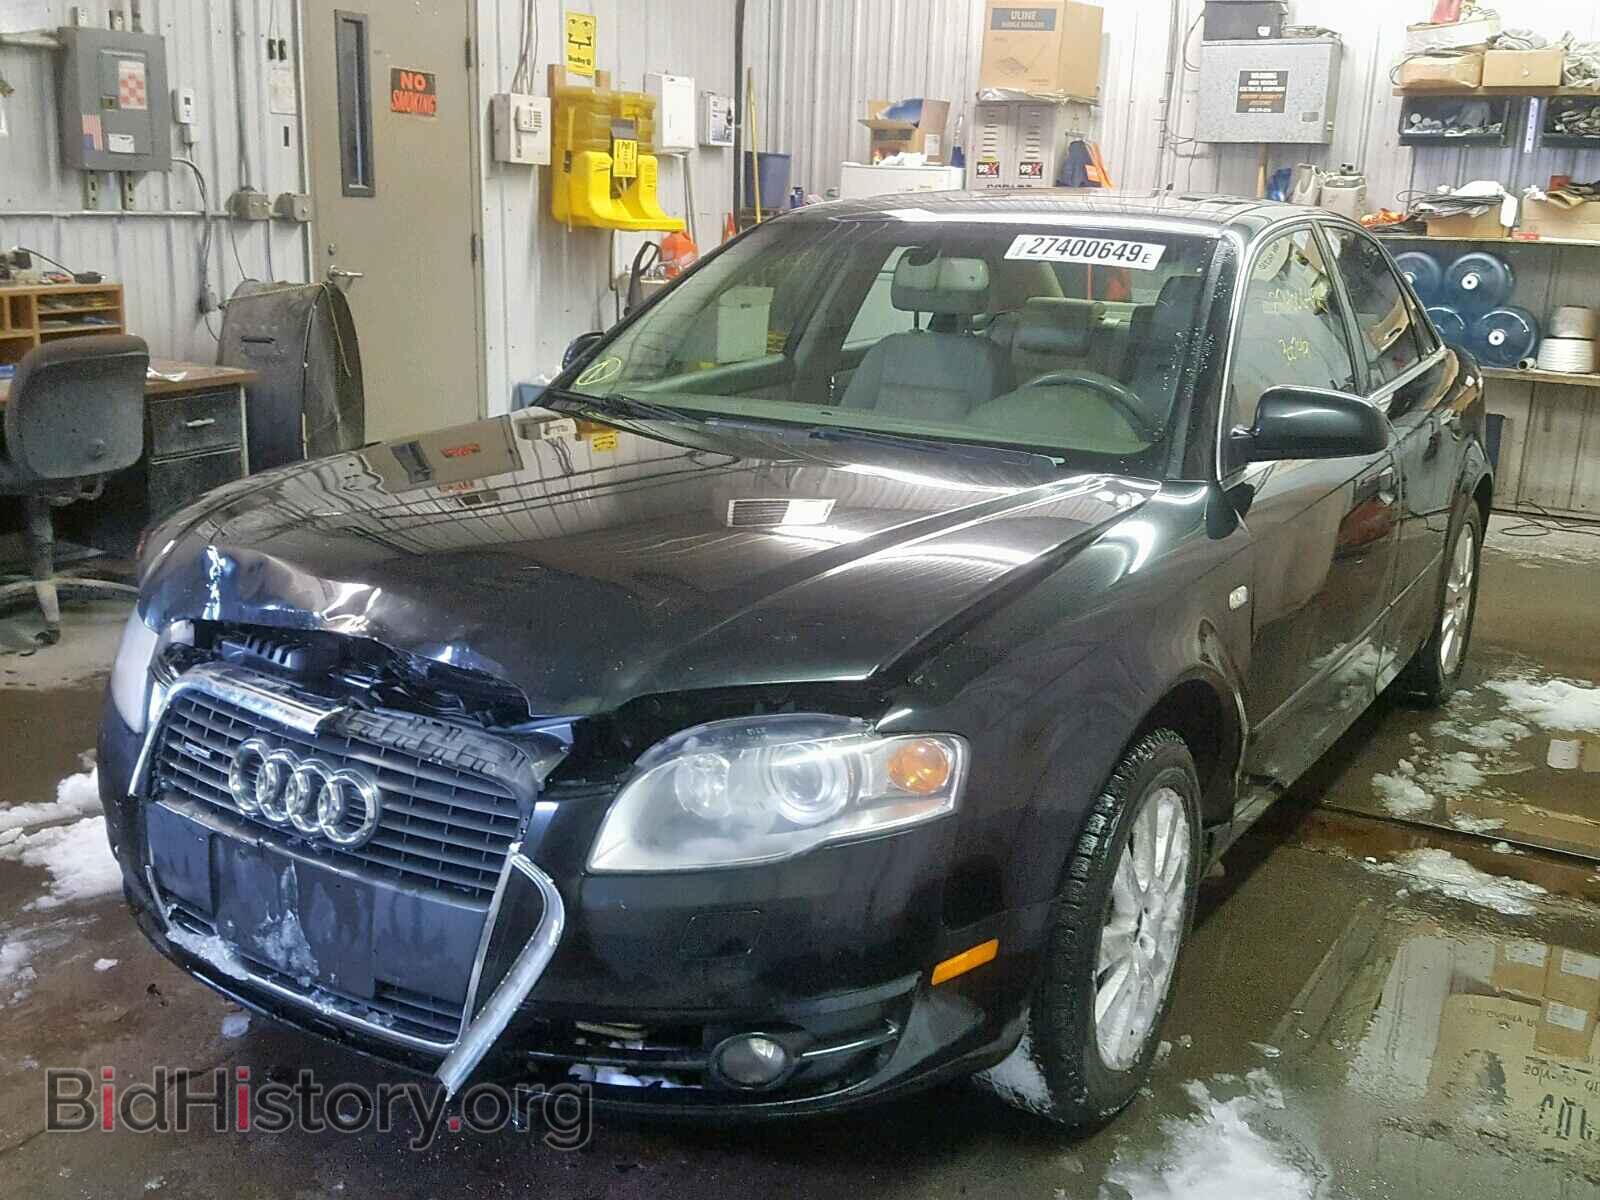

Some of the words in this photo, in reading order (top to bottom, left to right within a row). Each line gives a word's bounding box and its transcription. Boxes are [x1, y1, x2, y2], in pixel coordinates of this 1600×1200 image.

[400, 71, 426, 91] NO
[392, 89, 437, 113] SMOKING
[1027, 237, 1143, 262] 27400649
